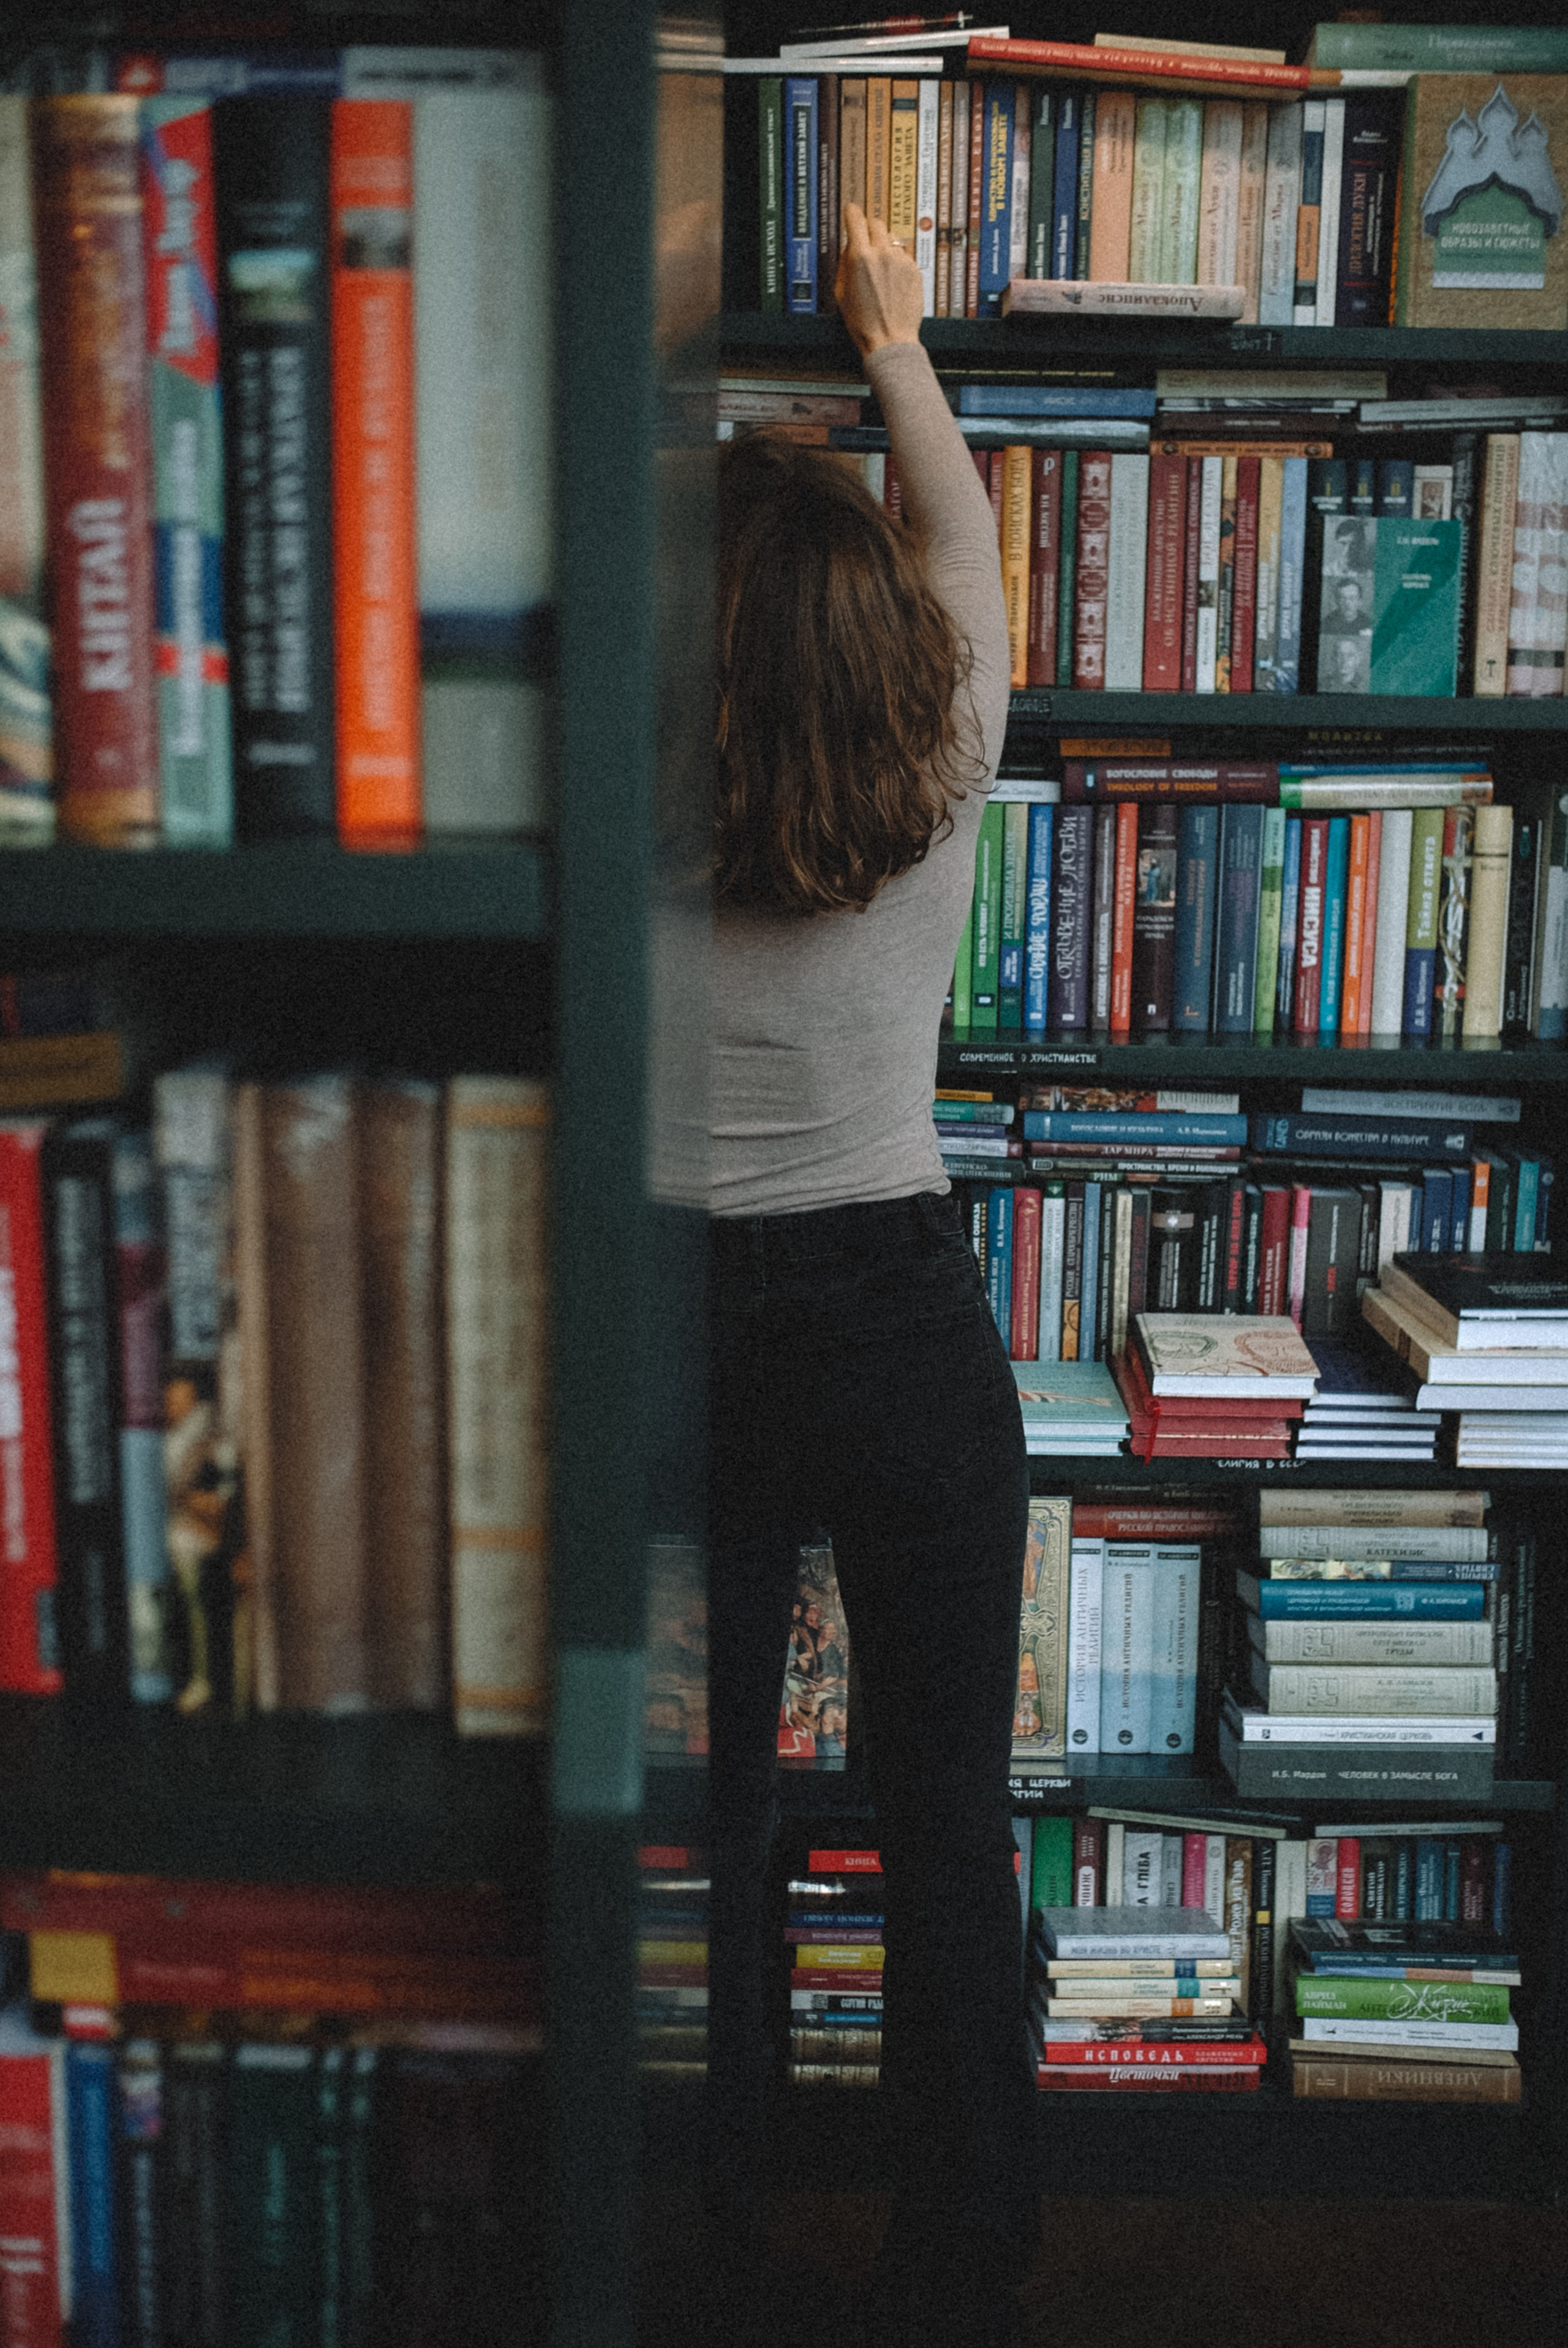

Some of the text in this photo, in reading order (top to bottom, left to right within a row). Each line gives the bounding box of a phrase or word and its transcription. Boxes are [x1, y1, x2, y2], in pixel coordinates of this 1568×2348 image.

[798, 111, 807, 138] ЗАВЕТ
[875, 87, 883, 129] КНИГОЙ
[973, 102, 982, 156] ЕНОХА
[998, 114, 1007, 154] ЗАВЕТЕ
[894, 127, 902, 224] ТЕКСТОЛОГИЯ
[903, 126, 913, 225] ВЕТХОГО ЗАВЕТА
[972, 166, 981, 218] КНИГА
[997, 157, 1006, 199] НОВОМ
[1352, 172, 1366, 210] ЛУКИ
[798, 186, 807, 233] ВВЕДЕНИЕ
[767, 221, 776, 255] ИСХОД
[1441, 237, 1541, 249] ОБРАЗЫ И СЮЖЕТЫ
[1452, 222, 1531, 235] НОВОЗАВЕТНЫЕ
[767, 259, 776, 293] КНИГА
[1099, 293, 1204, 312] Апокалипсис
[1010, 457, 1025, 489] БОГА
[1008, 493, 1023, 549] ПОИСКАХ
[1489, 507, 1503, 576] КЛЮЧЕВЫХ
[1164, 474, 1180, 647] ОБ ИСТИННОЙ РЕЛИГИИ
[1106, 769, 1218, 779] БОГОСЛОВИЕ СВОБОДЫ
[1077, 855, 1086, 899] ИСТИНА
[1417, 836, 1436, 939] Тайна ответа
[1004, 869, 1016, 929] ПРОИЗВЕЛА
[1056, 815, 1077, 980] ОТКРОВЕНИЕ ЛЮБВИ
[1301, 828, 1321, 968] УБИЙСТВО ИИСУСА
[1005, 931, 1012, 940] И
[1075, 904, 1085, 978] ТРИНИТАРНАЯ
[960, 1052, 1098, 1064] СОВРЕМЕННОЕ ХРИСТИАНСТВЕ
[1101, 1146, 1154, 1155] ДАР МИРА
[973, 1202, 981, 1236] ОБРАЗА
[1231, 1190, 1242, 1217] ВЕРЫ
[1227, 1256, 1238, 1290] ТЕРРОР
[1366, 1549, 1425, 1557] КАТЕХИЗИС
[1074, 1568, 1088, 1703] ИСТОРИЯ АНТИЧНЫХ
[1088, 1607, 1099, 1664] РЕЛИГИЙ
[1122, 1572, 1133, 1708] ИСТОРИЯ АНТИЧНЫХ РЕЛИГИЙ
[1176, 1573, 1187, 1708] ИСТОРИЯ АНТИЧНЫХ РЕЛИГИЙ
[1029, 1779, 1071, 1787] ЦЕРКВИ
[1272, 1770, 1290, 1779] И.Б.
[1337, 1770, 1379, 1780] ЧЕЛОВЕК
[1381, 1772, 1387, 1780] В
[1390, 1771, 1432, 1781] ЗАМЫСЛЕ
[1303, 1990, 1336, 2001] АВРИЛ
[1303, 1999, 1347, 2010] ПАЙМАН
[1085, 2050, 1184, 2062] ИСПОВЕДЬ
[1109, 2068, 1180, 2083] Цветочки
[1378, 2071, 1483, 2086] ДНЕВНИКИ
